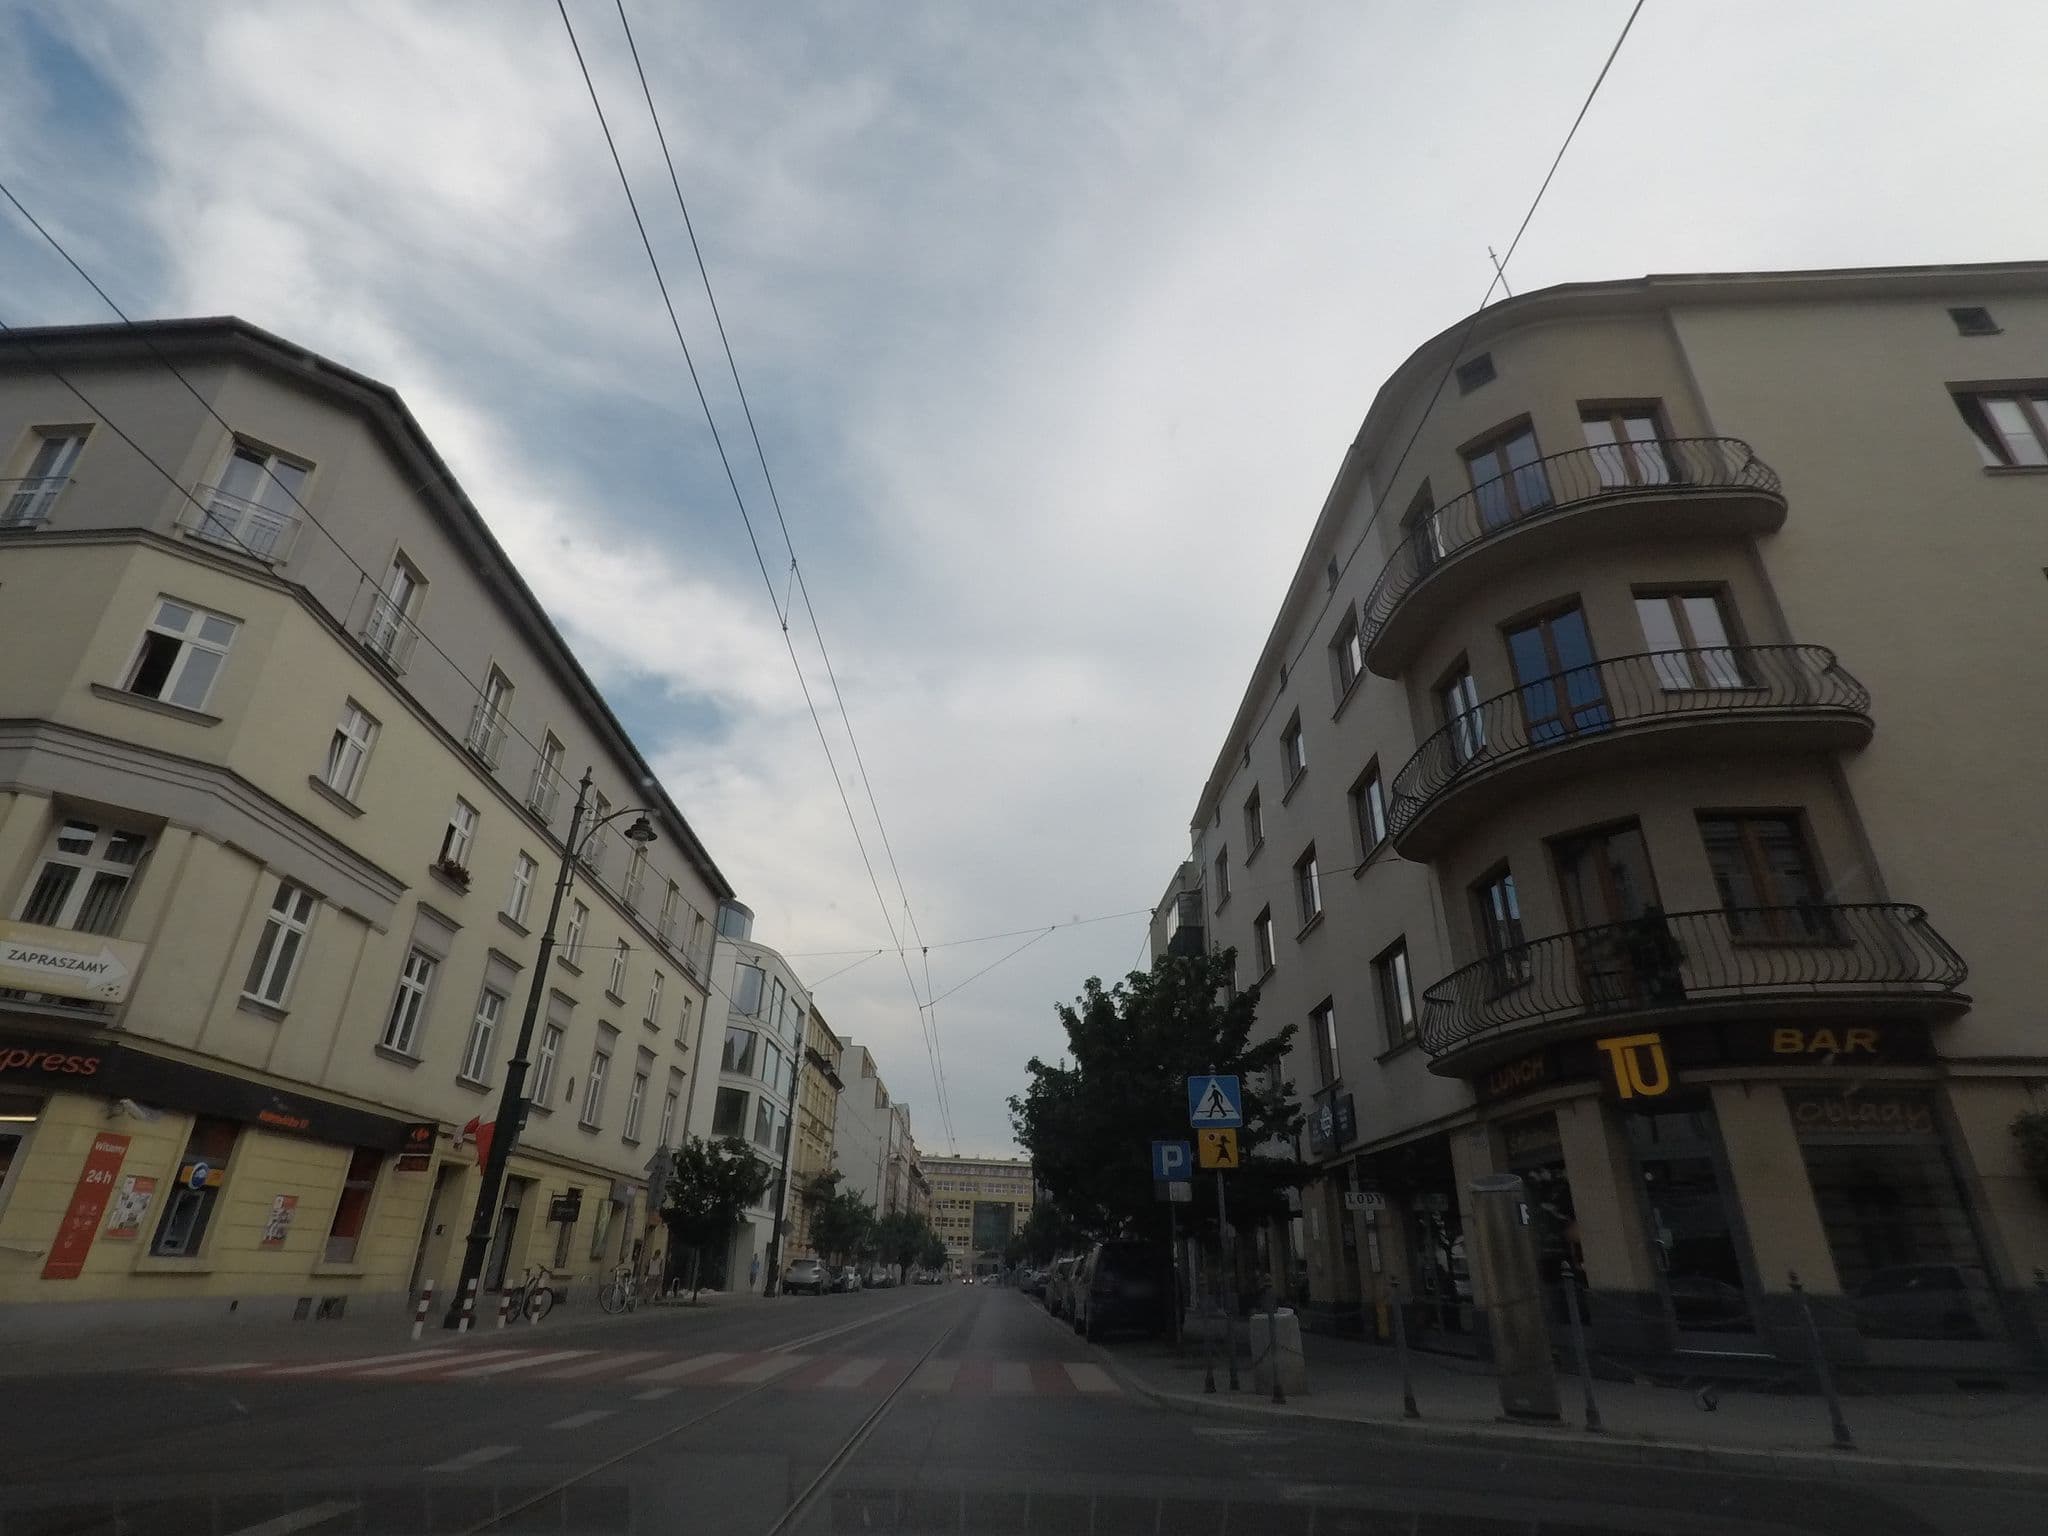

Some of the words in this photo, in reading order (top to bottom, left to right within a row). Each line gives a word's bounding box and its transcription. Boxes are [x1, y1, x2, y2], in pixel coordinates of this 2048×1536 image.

[8, 949, 109, 973] ZAPRASZAMY
[1772, 1028, 1880, 1055] BAR
[1488, 1056, 1545, 1095] LUNCH
[1596, 1032, 1671, 1100] TU
[1162, 1144, 1183, 1176] P
